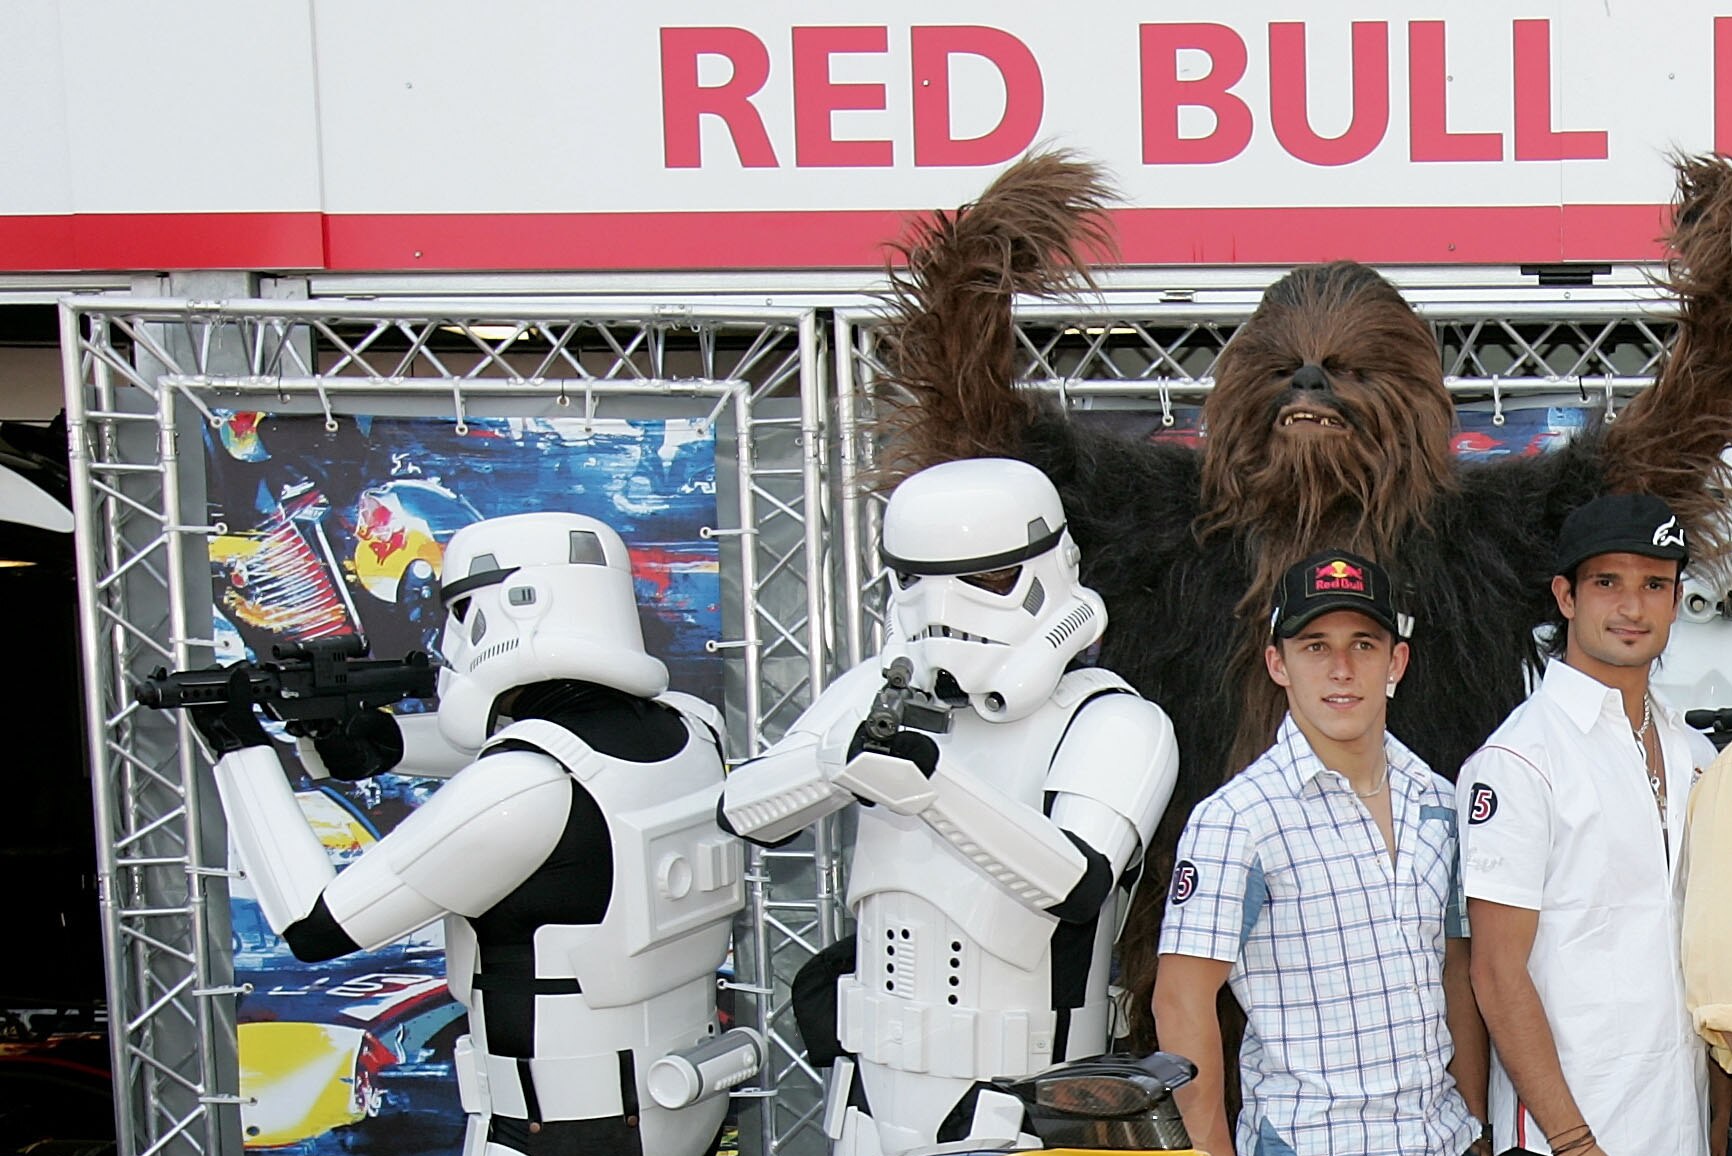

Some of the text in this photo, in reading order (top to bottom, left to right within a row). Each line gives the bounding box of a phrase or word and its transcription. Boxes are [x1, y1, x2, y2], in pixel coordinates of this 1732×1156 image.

[659, 24, 1045, 168] RED
[1138, 18, 1609, 166] BULL
[1315, 578, 1364, 591] Red Bull
[1469, 789, 1493, 820] 5
